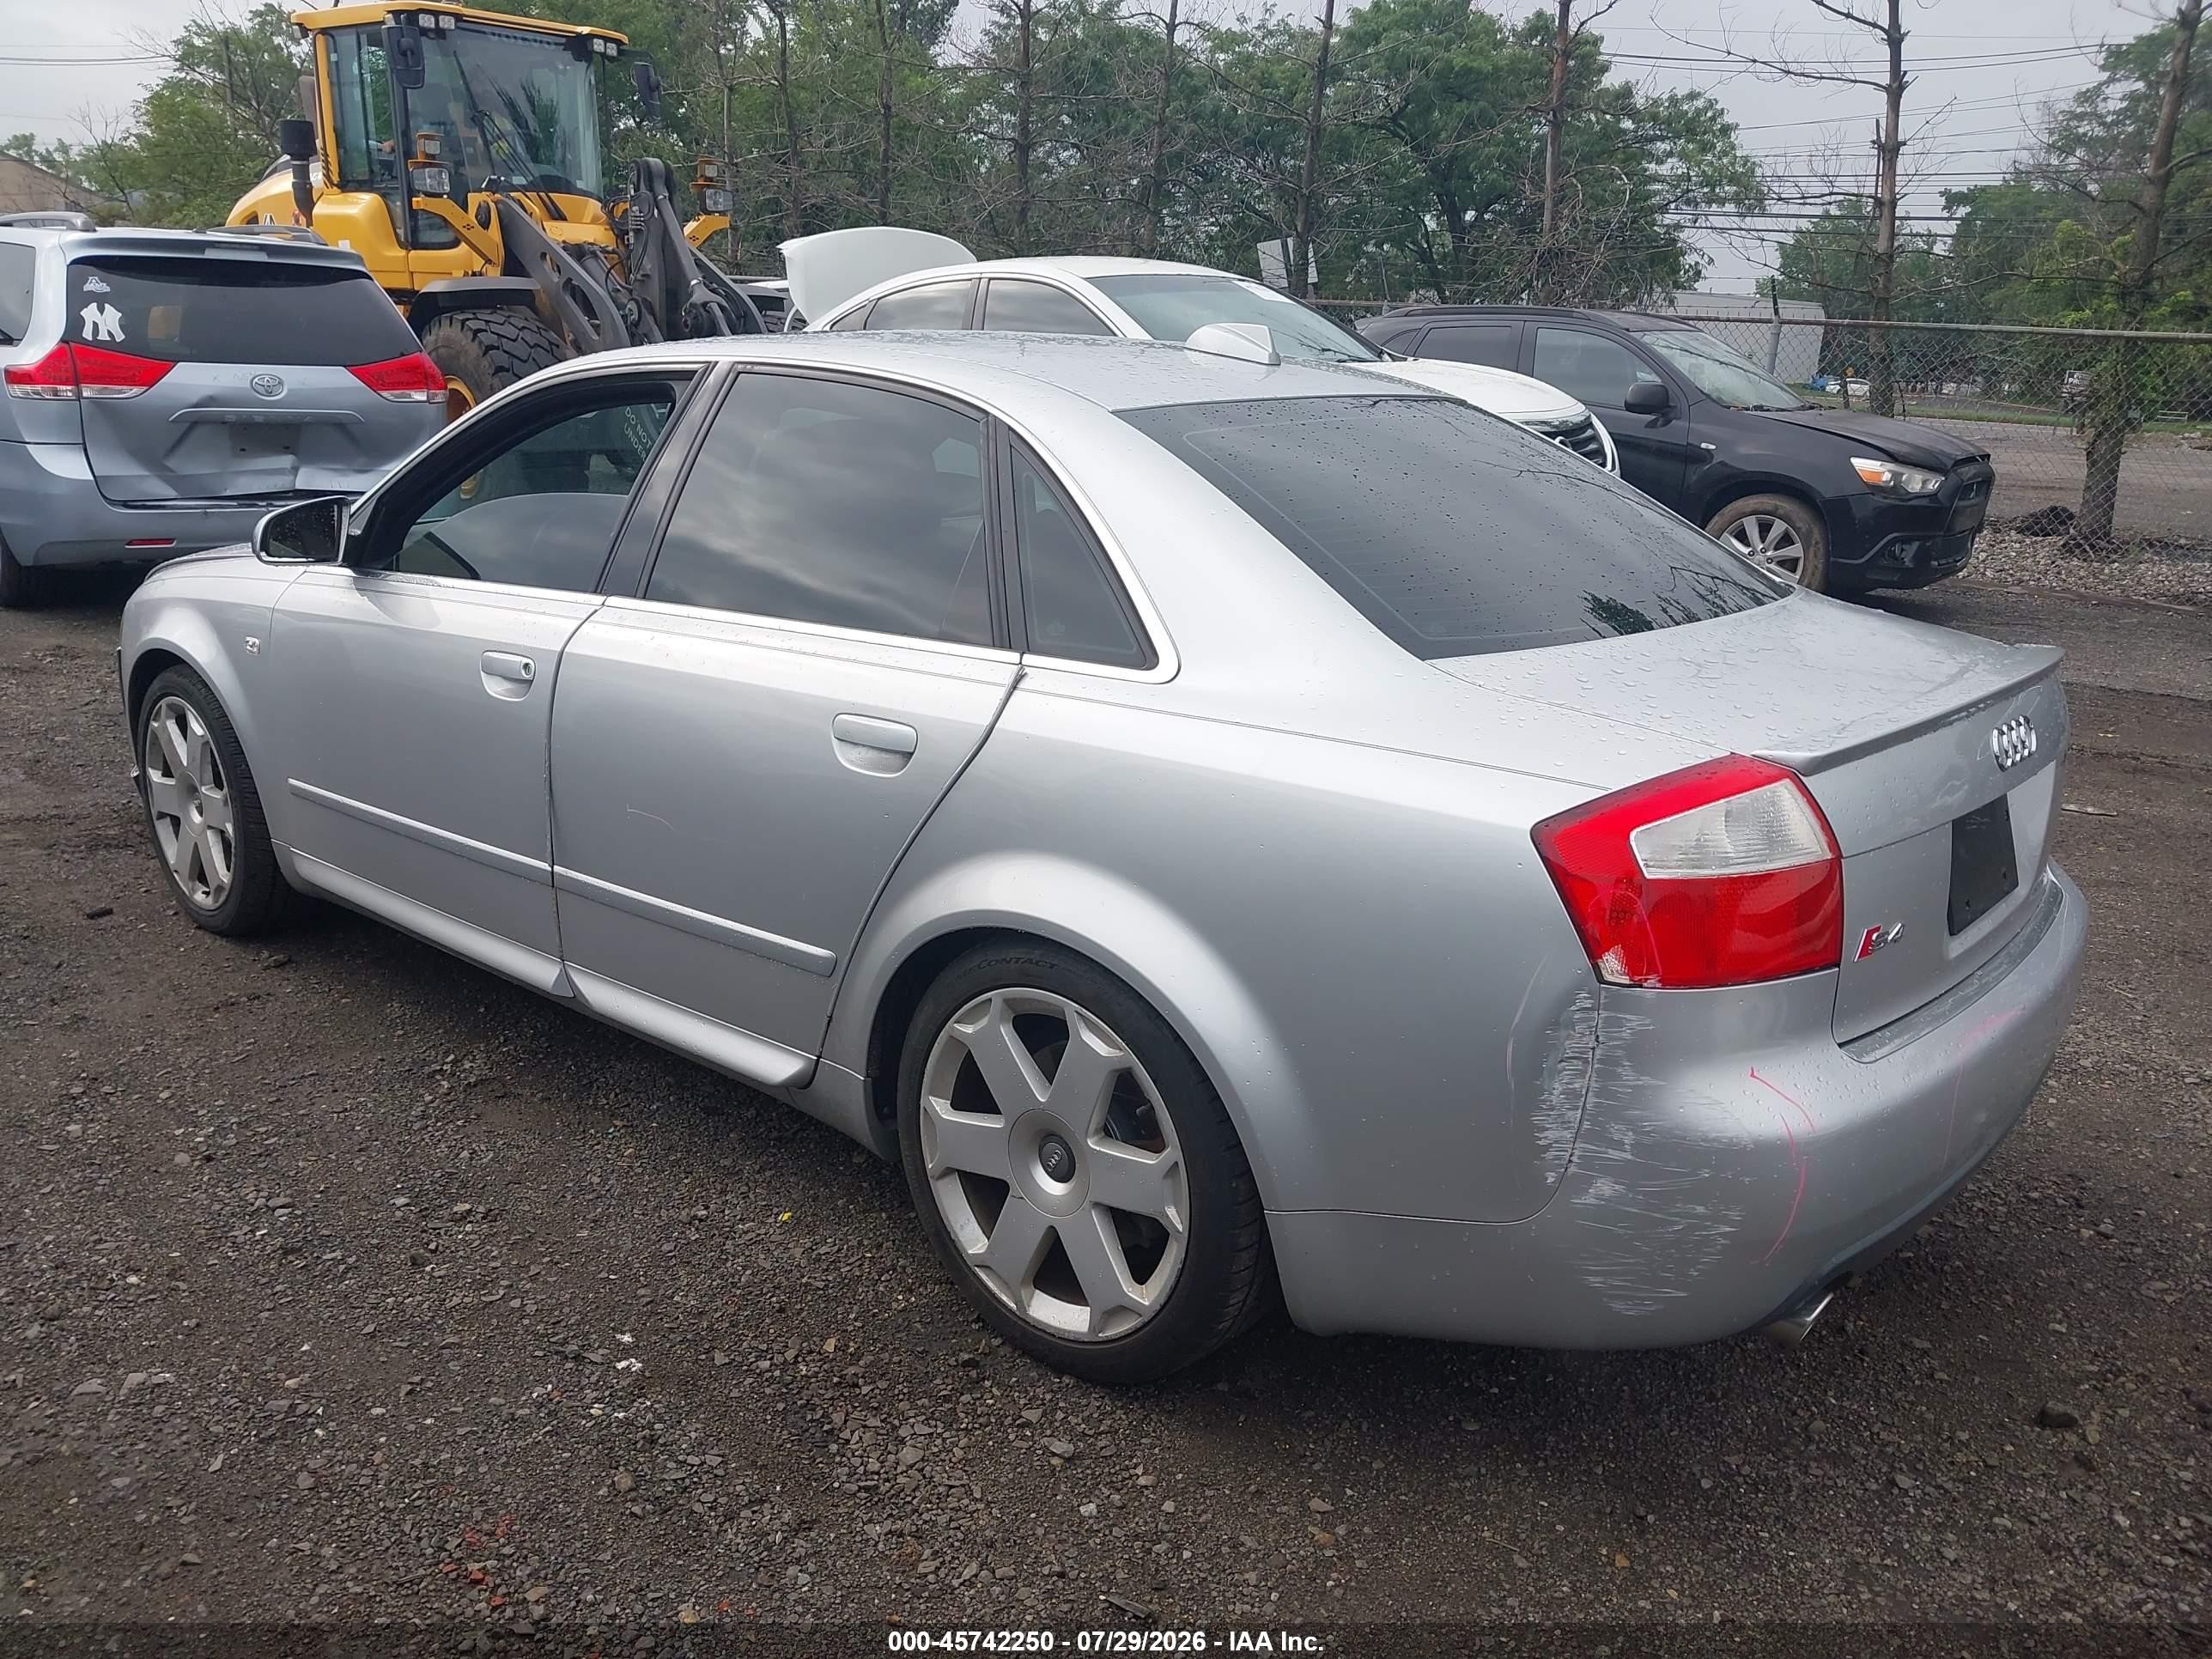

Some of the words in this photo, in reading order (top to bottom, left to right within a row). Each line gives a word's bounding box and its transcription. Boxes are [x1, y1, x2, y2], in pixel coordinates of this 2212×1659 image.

[623, 422, 647, 462] UNDER
[625, 406, 635, 424] DO
[636, 423, 652, 448] NOT
